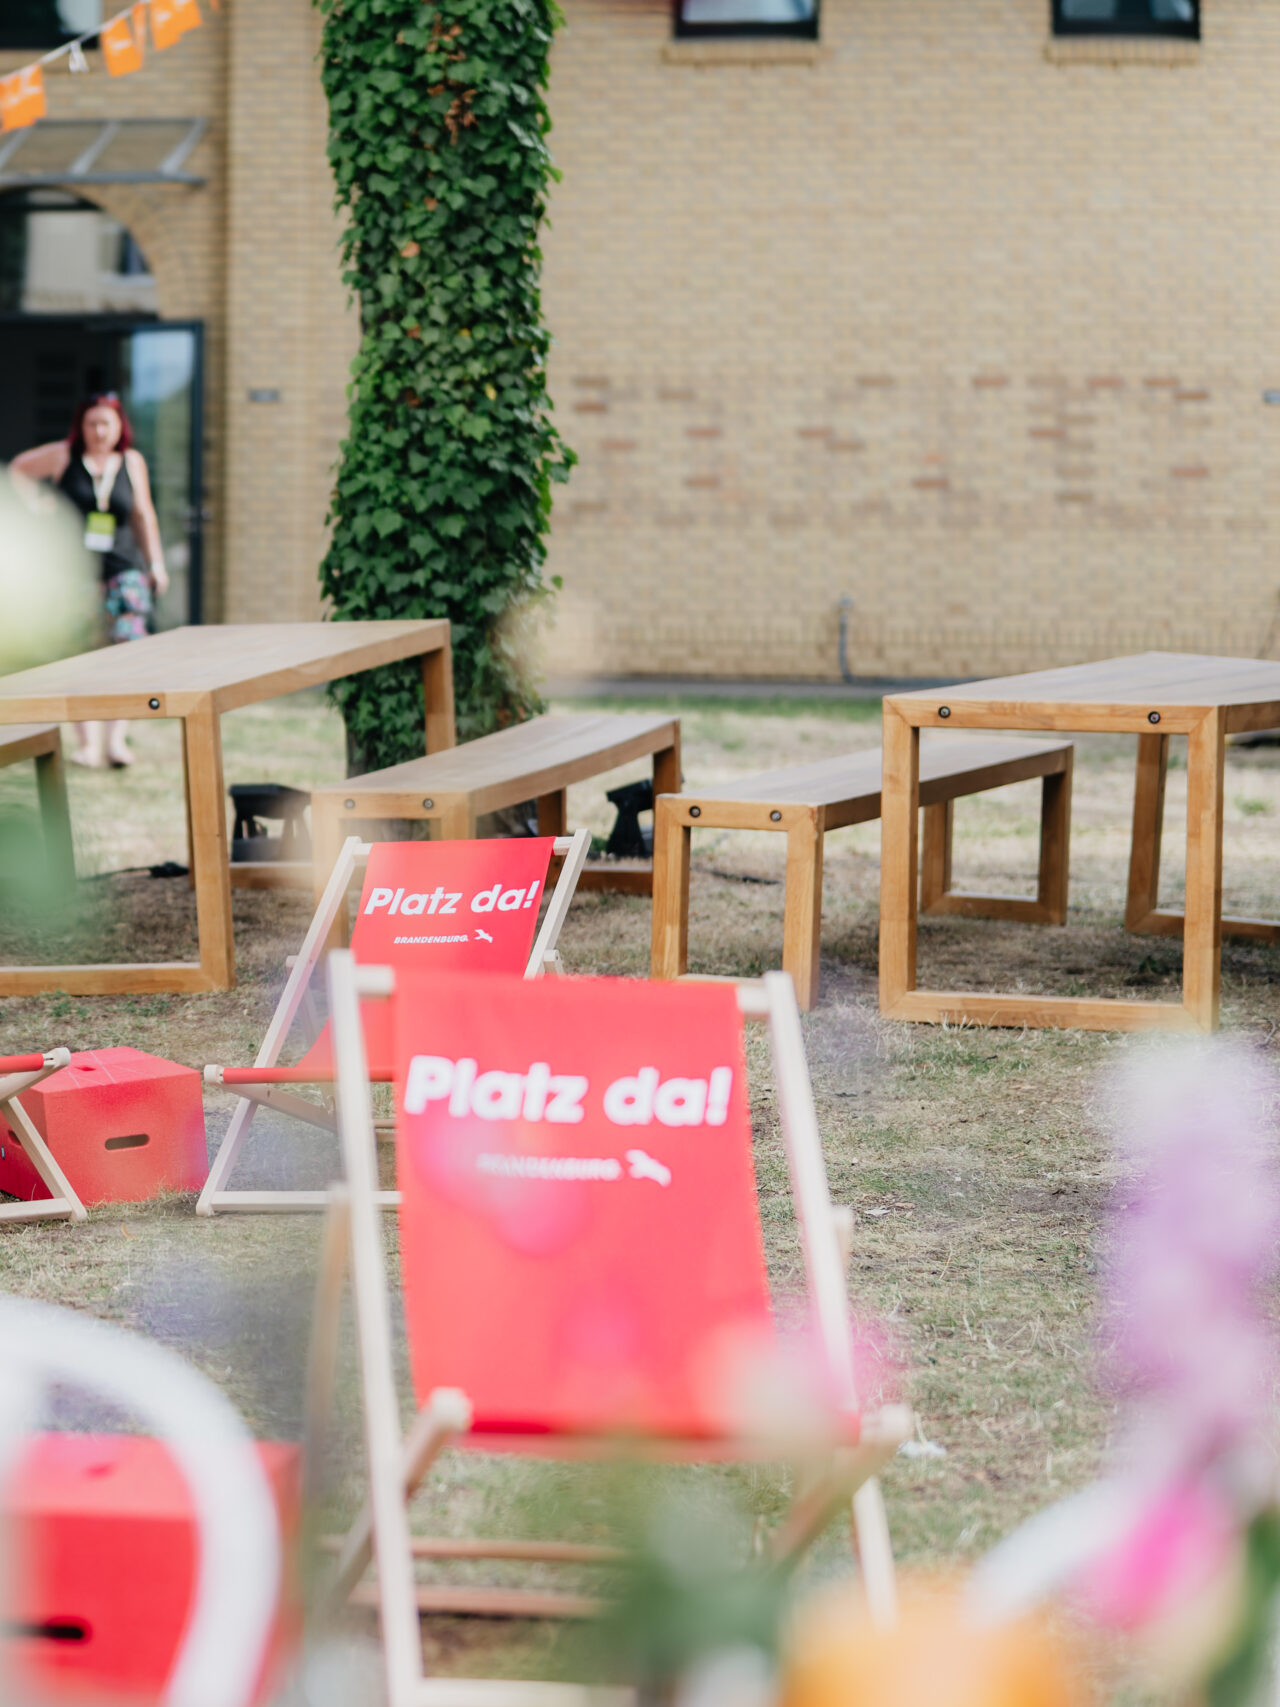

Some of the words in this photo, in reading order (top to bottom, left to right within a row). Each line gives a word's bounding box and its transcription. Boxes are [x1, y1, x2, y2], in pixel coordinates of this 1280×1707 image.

[364, 887, 463, 915] Platz
[470, 880, 541, 913] da!
[403, 1055, 588, 1124] Platz
[603, 1066, 733, 1127] da!
